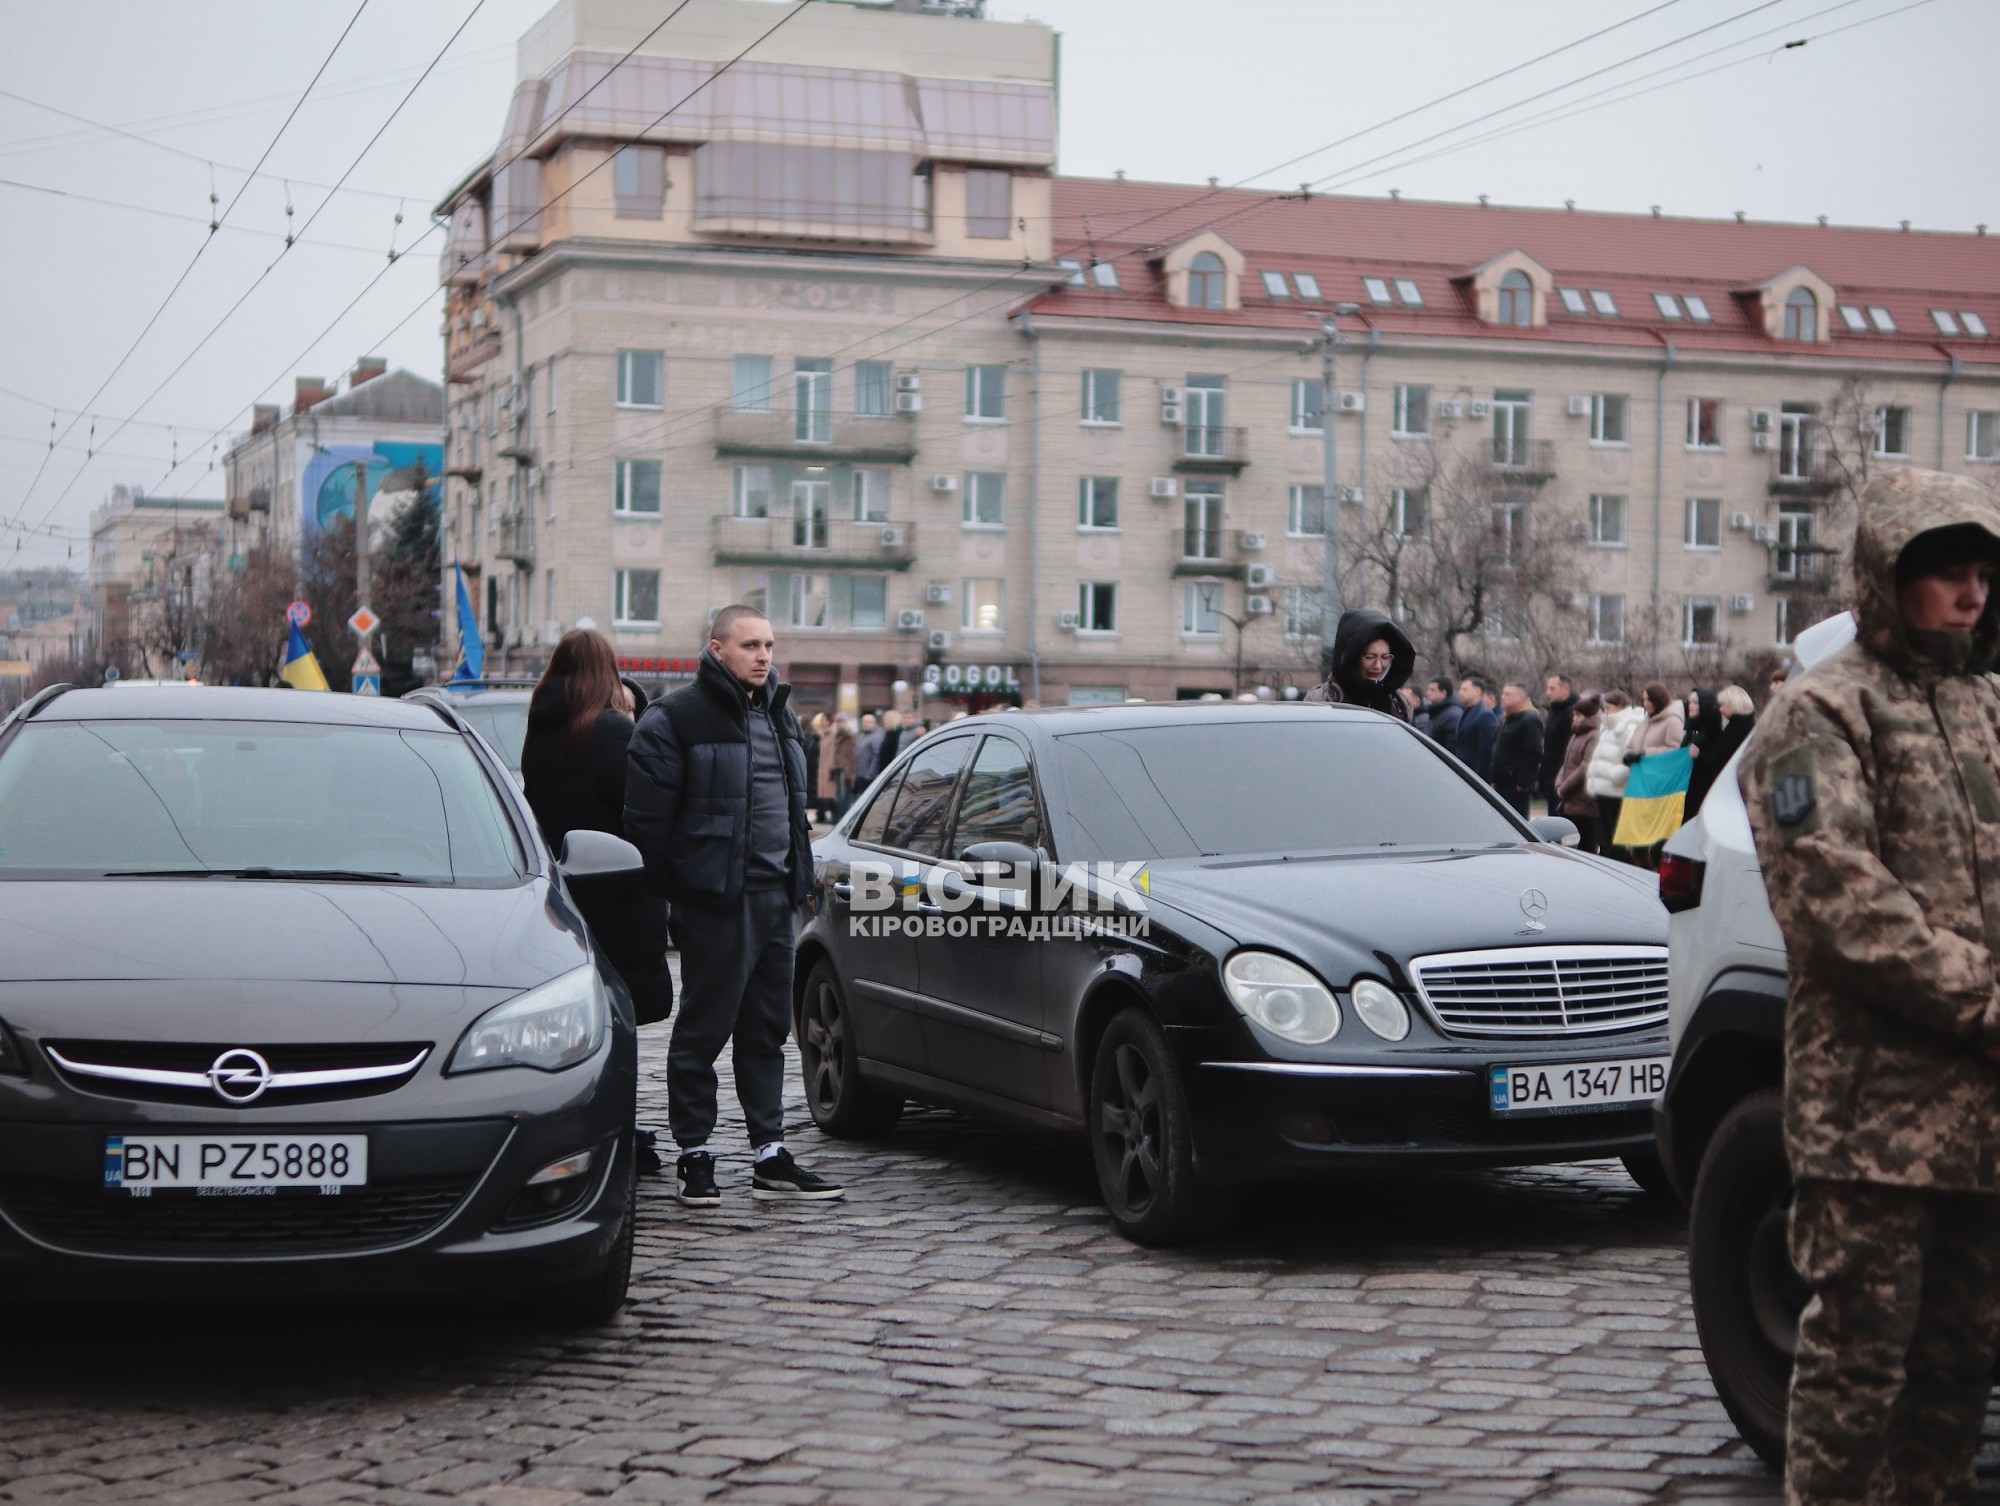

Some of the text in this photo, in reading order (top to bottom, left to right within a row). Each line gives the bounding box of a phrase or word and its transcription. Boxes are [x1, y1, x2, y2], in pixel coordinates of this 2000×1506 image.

[924, 664, 1019, 685] GOGOL
[1512, 1063, 1666, 1102] BA 1347 HB
[1495, 1094, 1508, 1104] UA
[123, 1142, 350, 1180] BN PZ5888
[105, 1170, 122, 1182] UA
